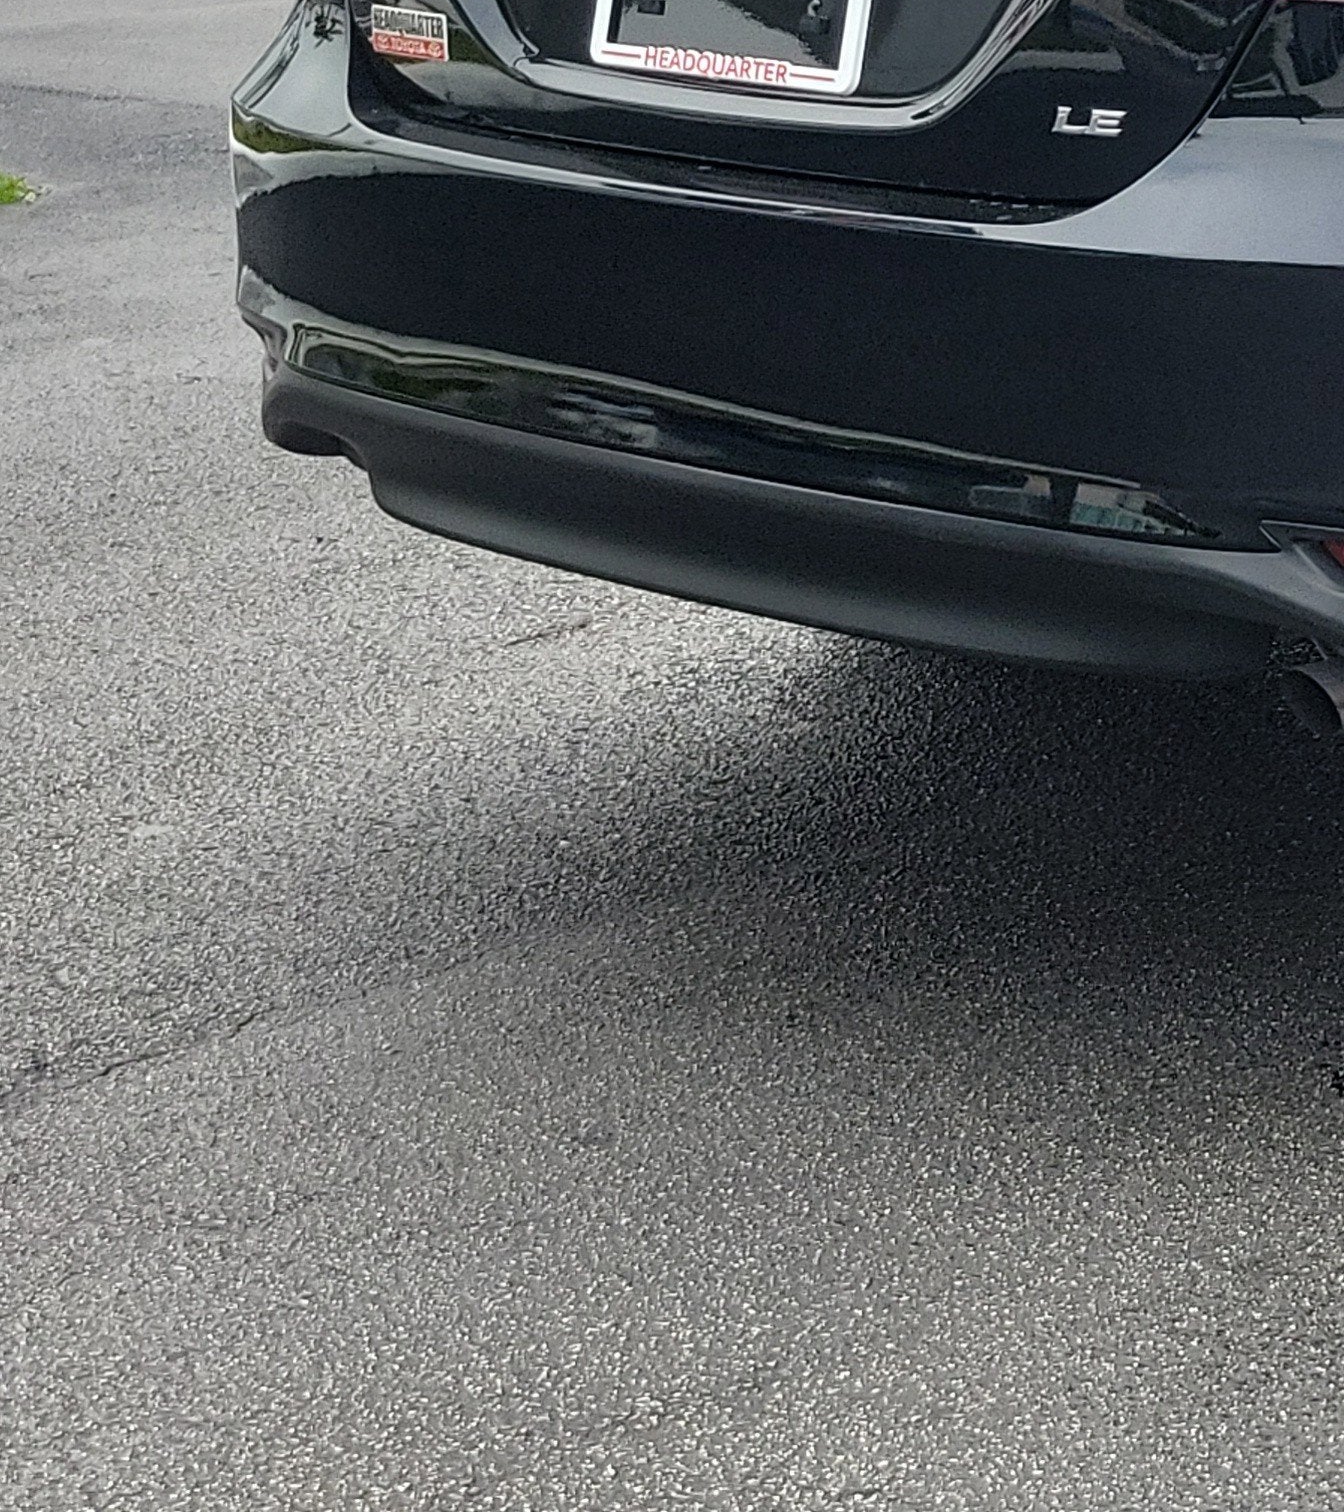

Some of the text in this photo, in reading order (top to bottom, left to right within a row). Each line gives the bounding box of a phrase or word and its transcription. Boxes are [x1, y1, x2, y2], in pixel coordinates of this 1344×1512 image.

[373, 8, 445, 41] HEADQUARTER
[644, 45, 789, 84] HEADQUARTER
[1051, 105, 1128, 138] LE
